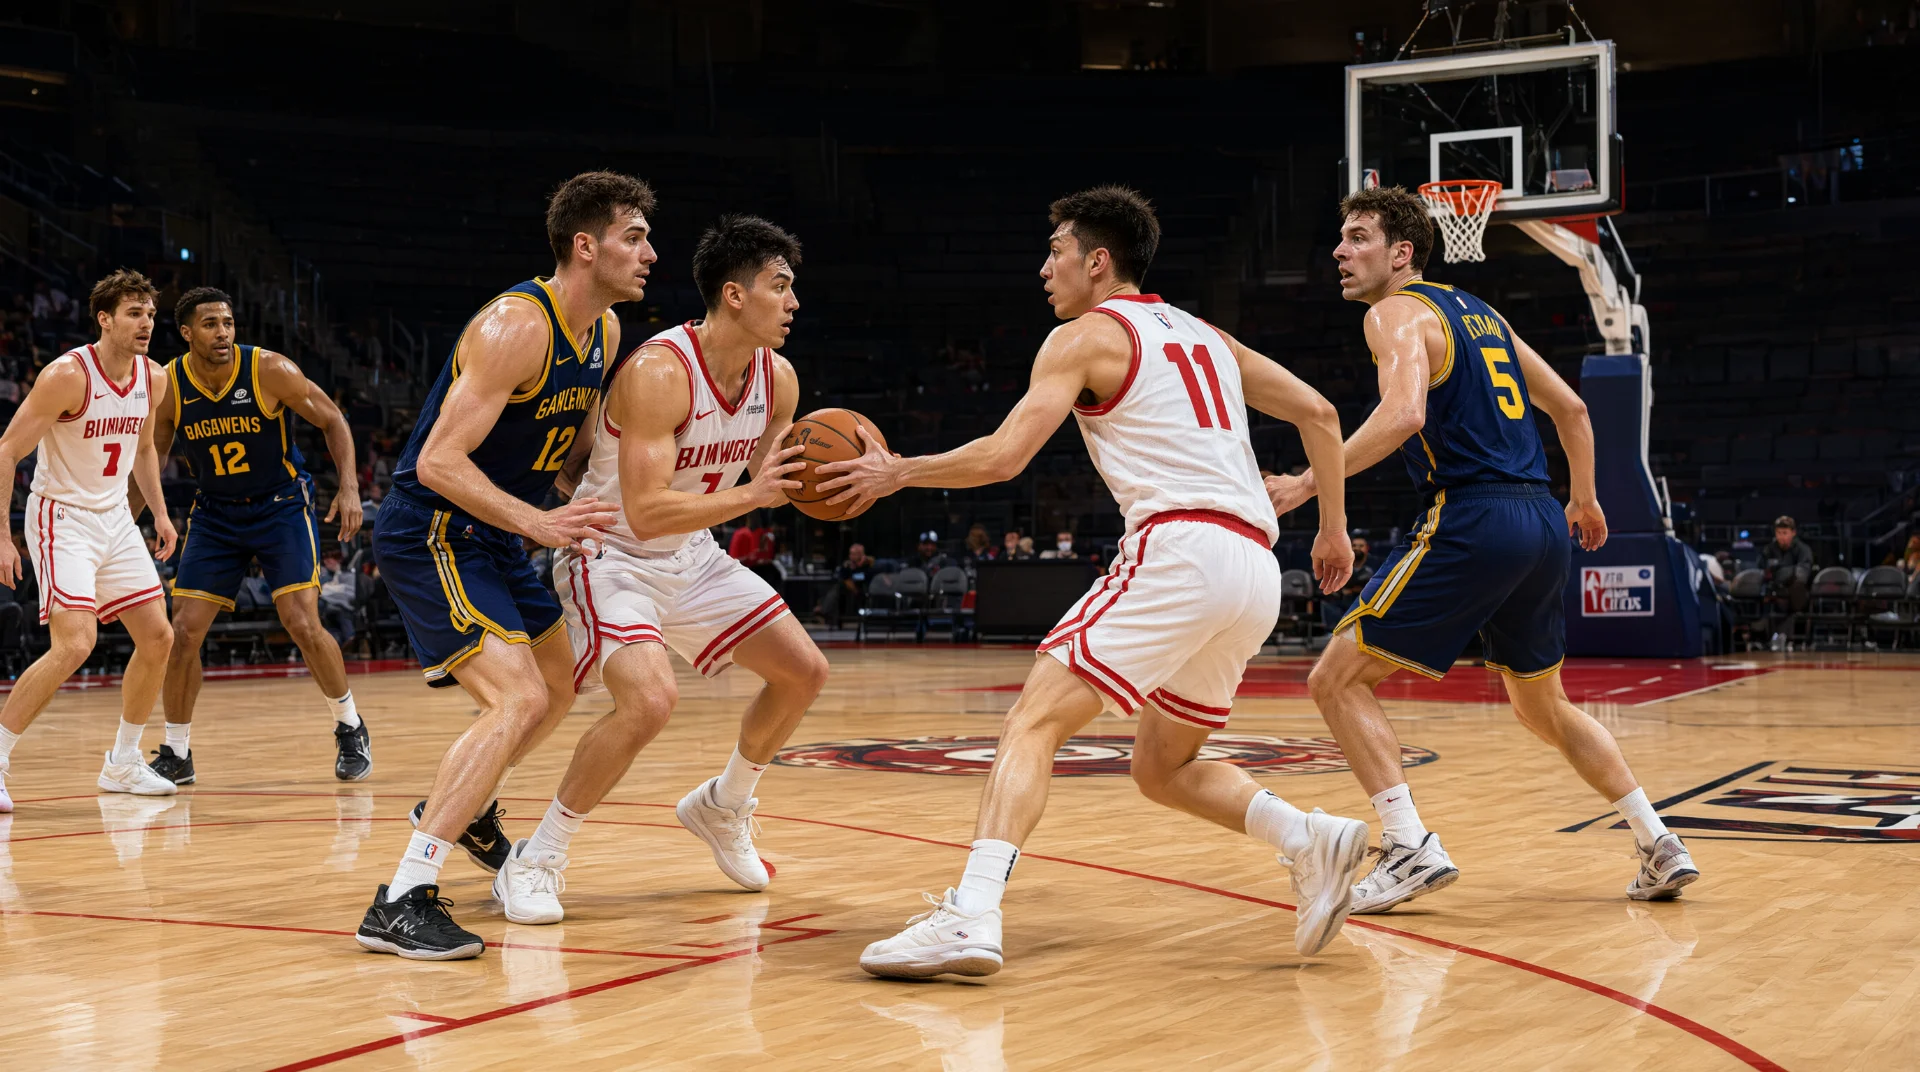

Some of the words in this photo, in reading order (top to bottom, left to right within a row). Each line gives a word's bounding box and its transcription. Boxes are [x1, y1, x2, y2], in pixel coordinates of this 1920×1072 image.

[1162, 343, 1232, 431] 11
[1480, 347, 1525, 420] 5
[102, 443, 121, 476] 7
[209, 441, 250, 476] 12
[531, 426, 576, 471] 12
[701, 472, 723, 494] 7
